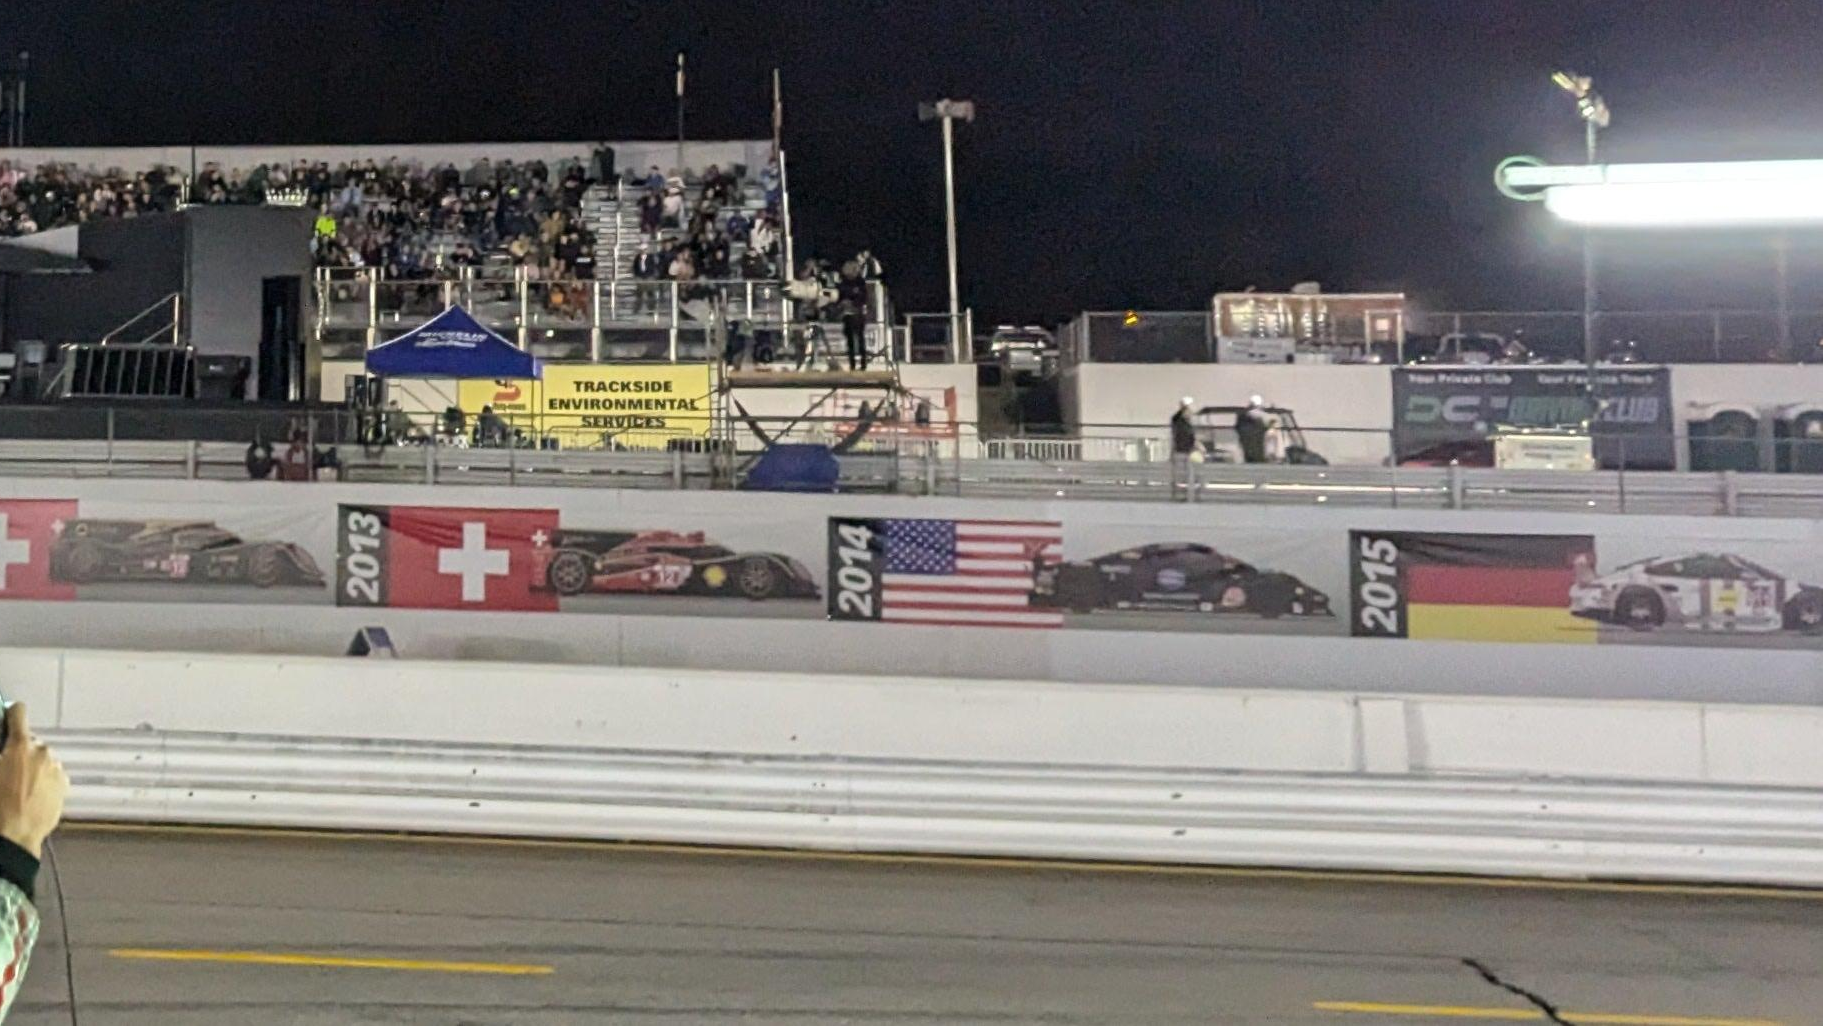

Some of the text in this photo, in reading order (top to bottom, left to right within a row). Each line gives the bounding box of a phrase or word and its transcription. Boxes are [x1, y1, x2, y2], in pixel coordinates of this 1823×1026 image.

[548, 398, 700, 411] ENVIRONMENTAL
[573, 380, 673, 394] TRACKSIDE
[581, 415, 667, 429] SERVICES
[346, 510, 381, 604] 2013
[838, 523, 873, 617] 2014
[1360, 535, 1398, 633] 2015
